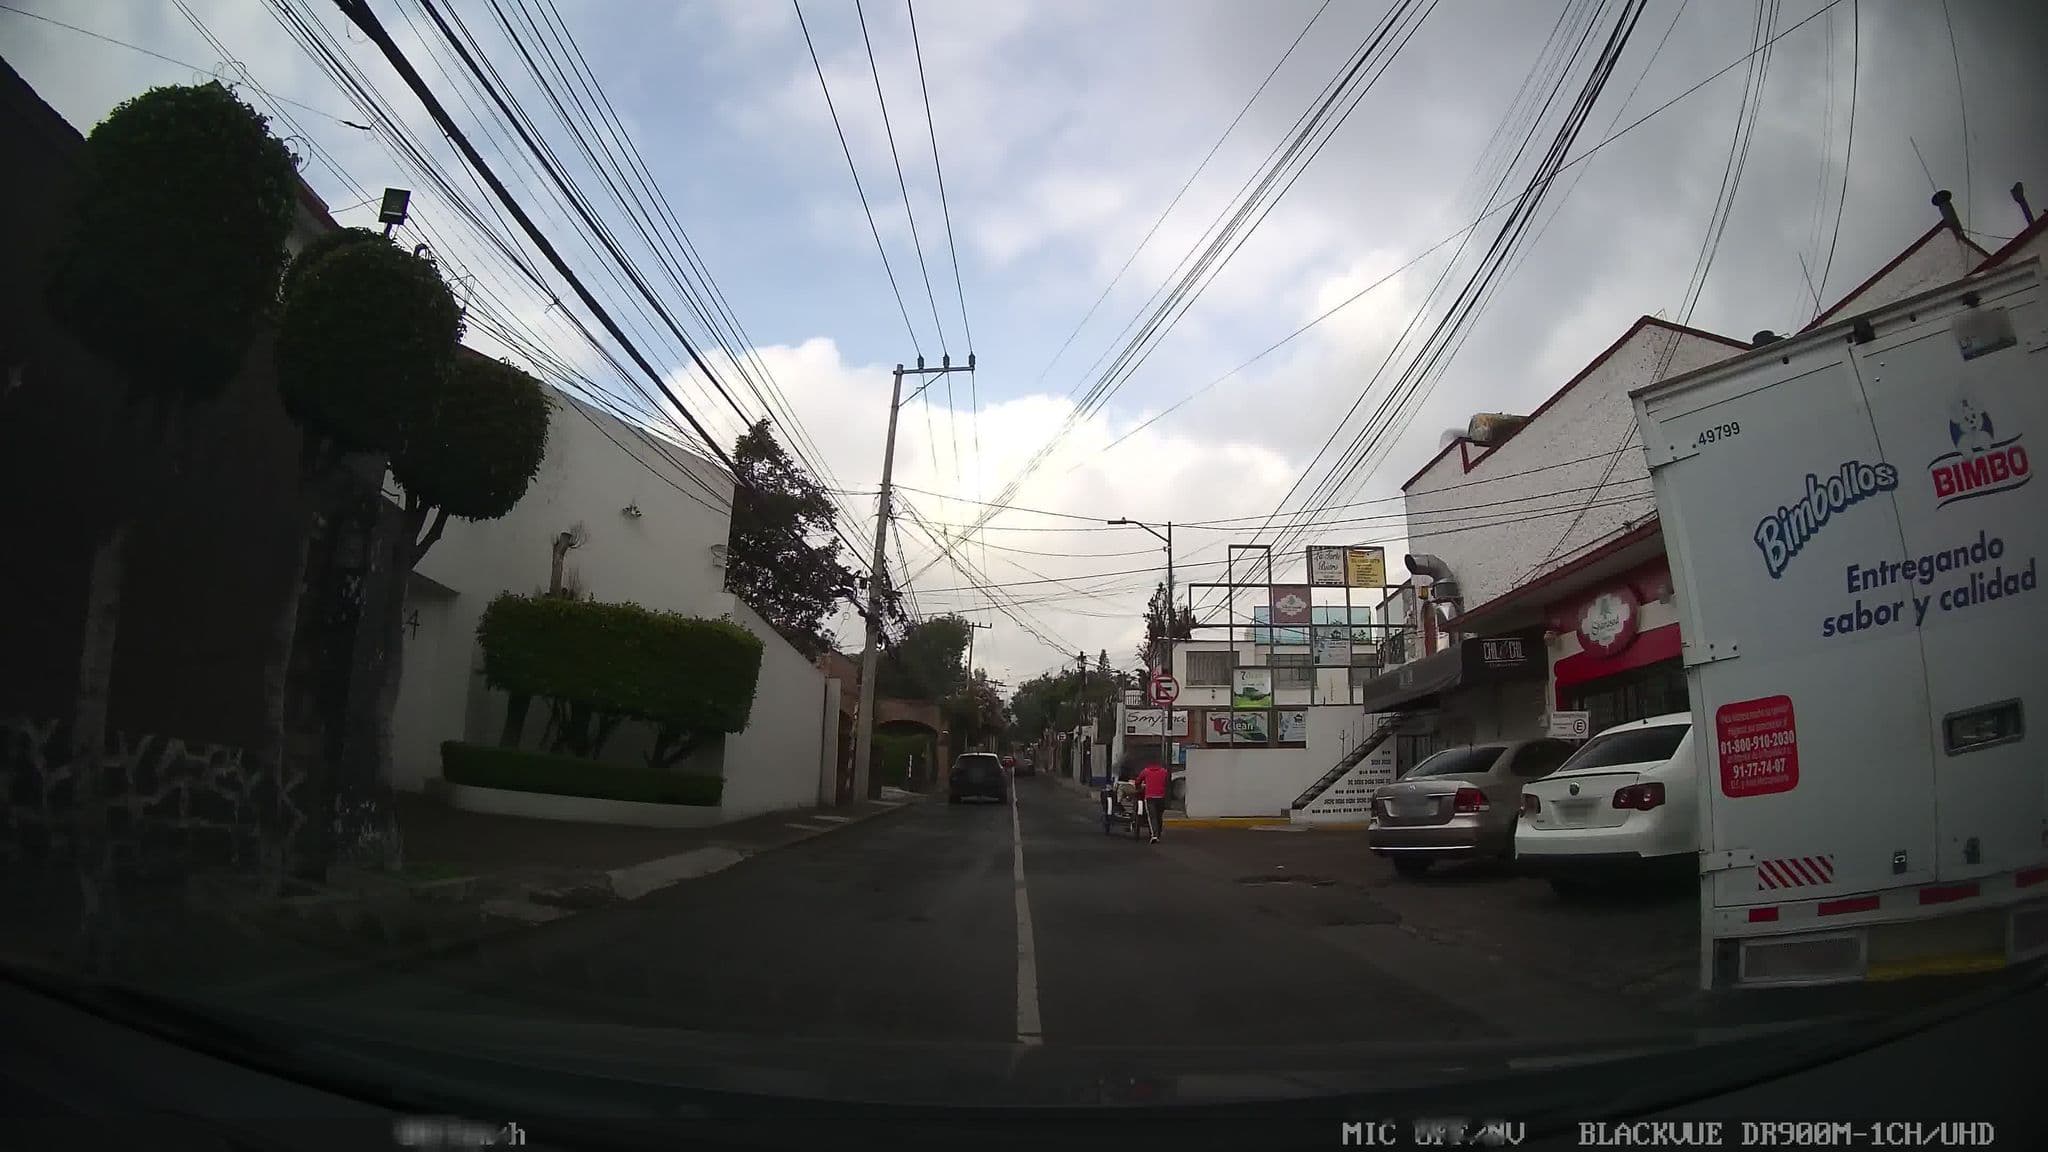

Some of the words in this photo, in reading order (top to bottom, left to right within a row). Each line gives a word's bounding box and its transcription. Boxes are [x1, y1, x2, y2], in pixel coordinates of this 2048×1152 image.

[1698, 420, 1741, 446] 49799
[1931, 445, 2030, 498] BIMBO
[1754, 460, 1899, 579] Bimbollos
[1846, 530, 2005, 594] Entregando
[1822, 600, 1904, 637] sabor
[1912, 596, 1932, 627] y
[1938, 558, 2038, 612] calidad
[1127, 711, 1187, 727] Smyna
